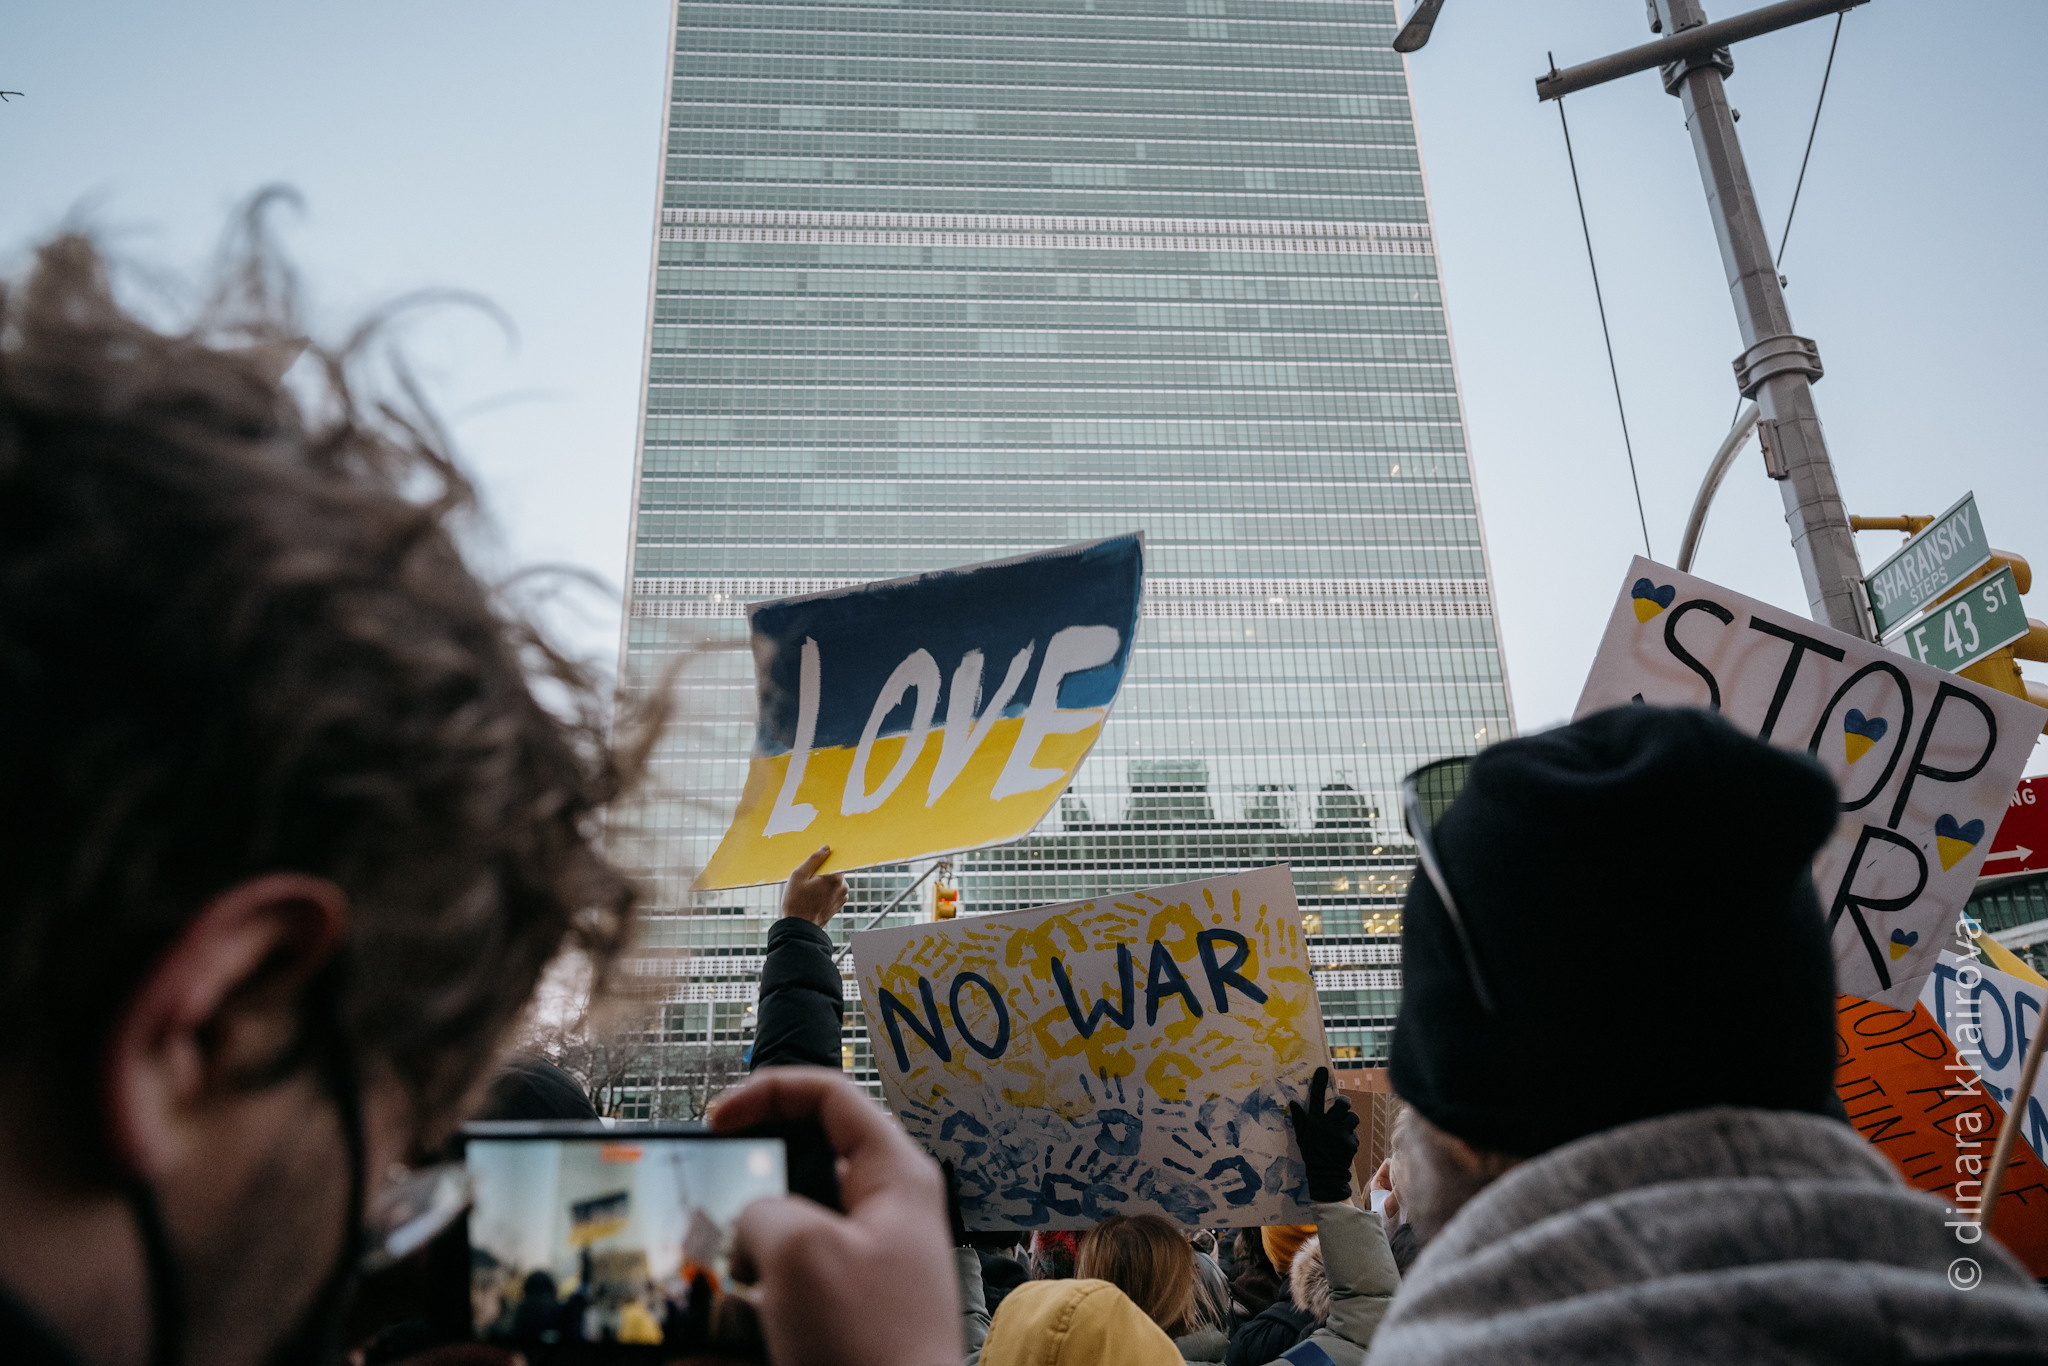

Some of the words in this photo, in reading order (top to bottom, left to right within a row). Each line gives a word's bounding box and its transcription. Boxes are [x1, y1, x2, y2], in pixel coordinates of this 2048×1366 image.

[1872, 506, 1974, 610] SHARANSKY
[1909, 566, 1949, 606] STEPS
[1943, 601, 1980, 659] 43
[1982, 577, 2008, 613] ST
[762, 624, 1121, 838] LOVE
[1664, 598, 1998, 829] STOP
[877, 971, 1011, 1073] NO
[1051, 927, 1269, 1040] WAR
